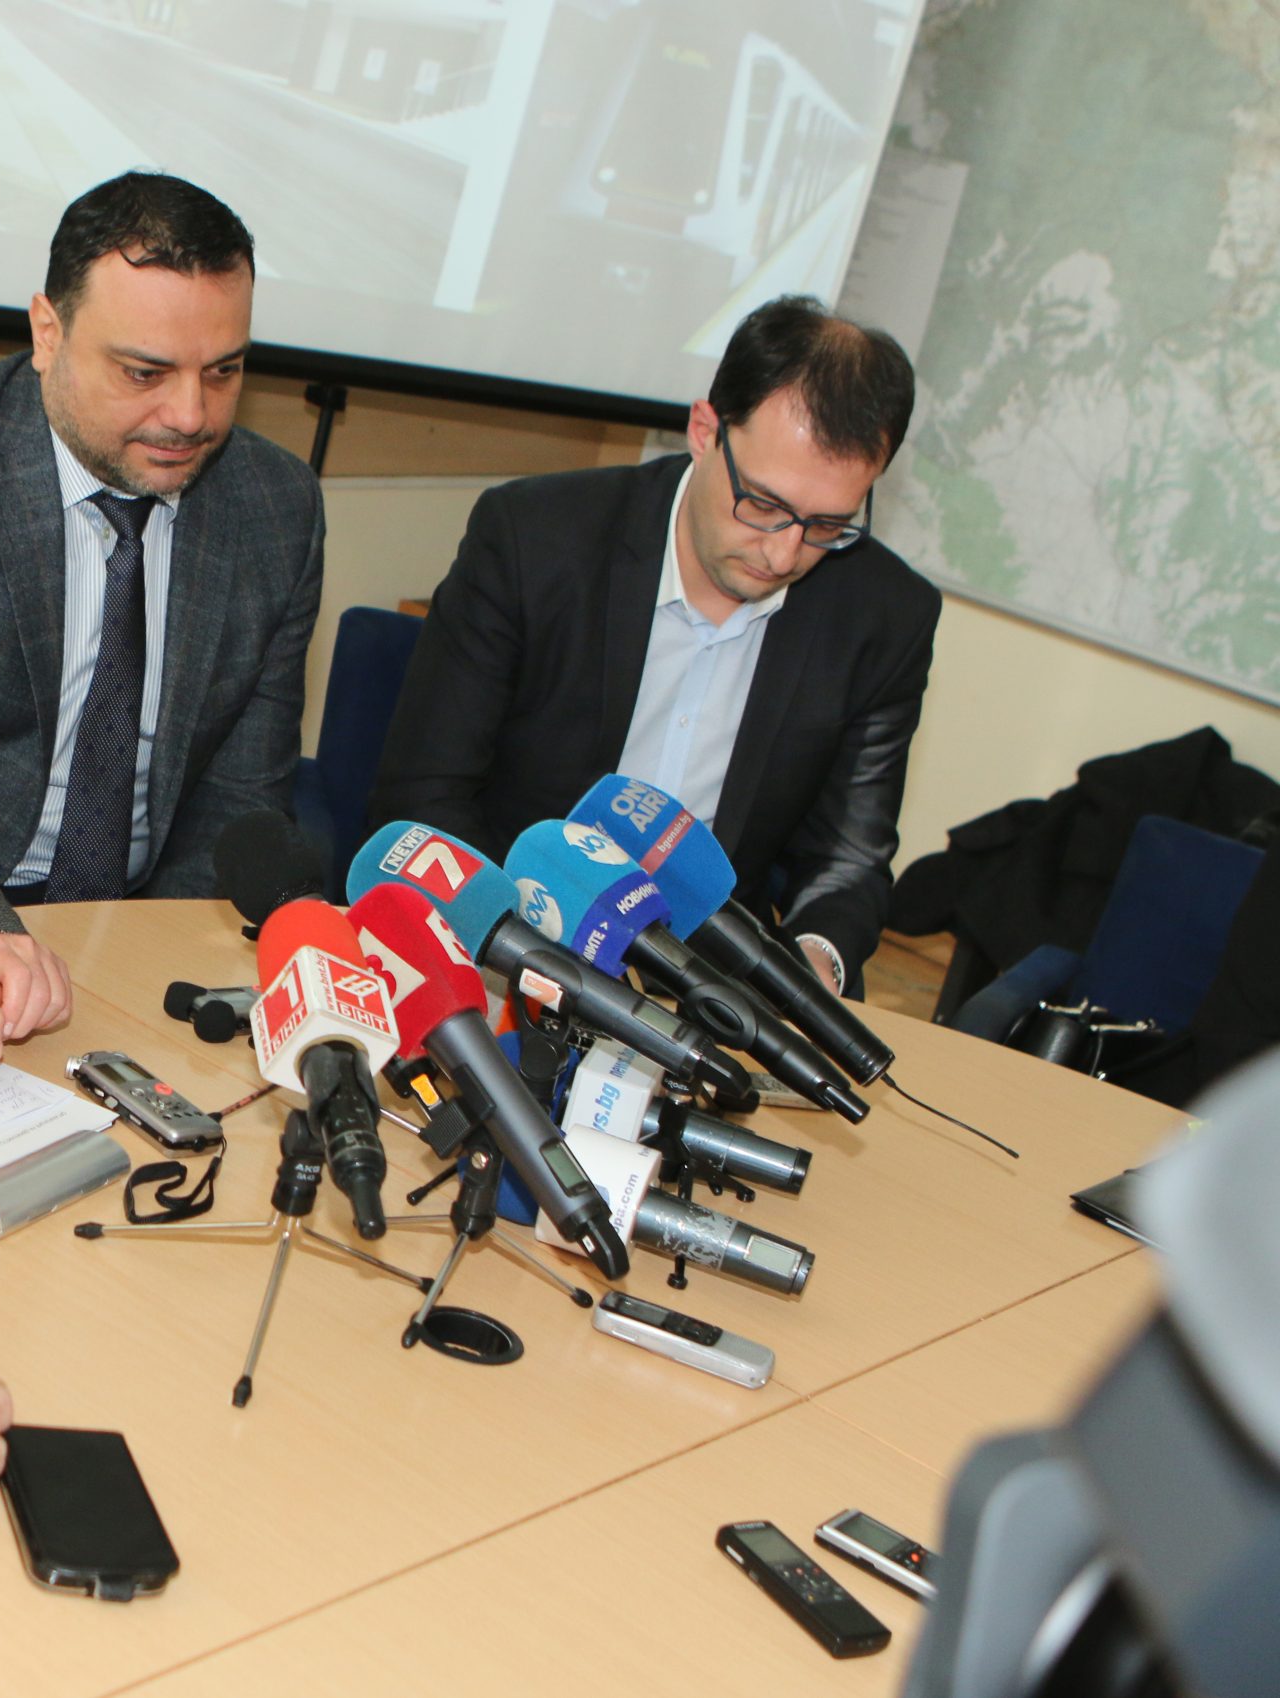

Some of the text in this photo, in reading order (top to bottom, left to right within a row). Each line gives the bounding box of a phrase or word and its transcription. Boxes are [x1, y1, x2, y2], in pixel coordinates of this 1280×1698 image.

[629, 791, 669, 834] AIR
[656, 814, 692, 854] bgonair.bg
[385, 830, 428, 868] NEWS
[406, 841, 466, 891] 7
[523, 886, 550, 929] OVA
[271, 1003, 308, 1056] БНТ
[338, 1003, 389, 1033] БНТ
